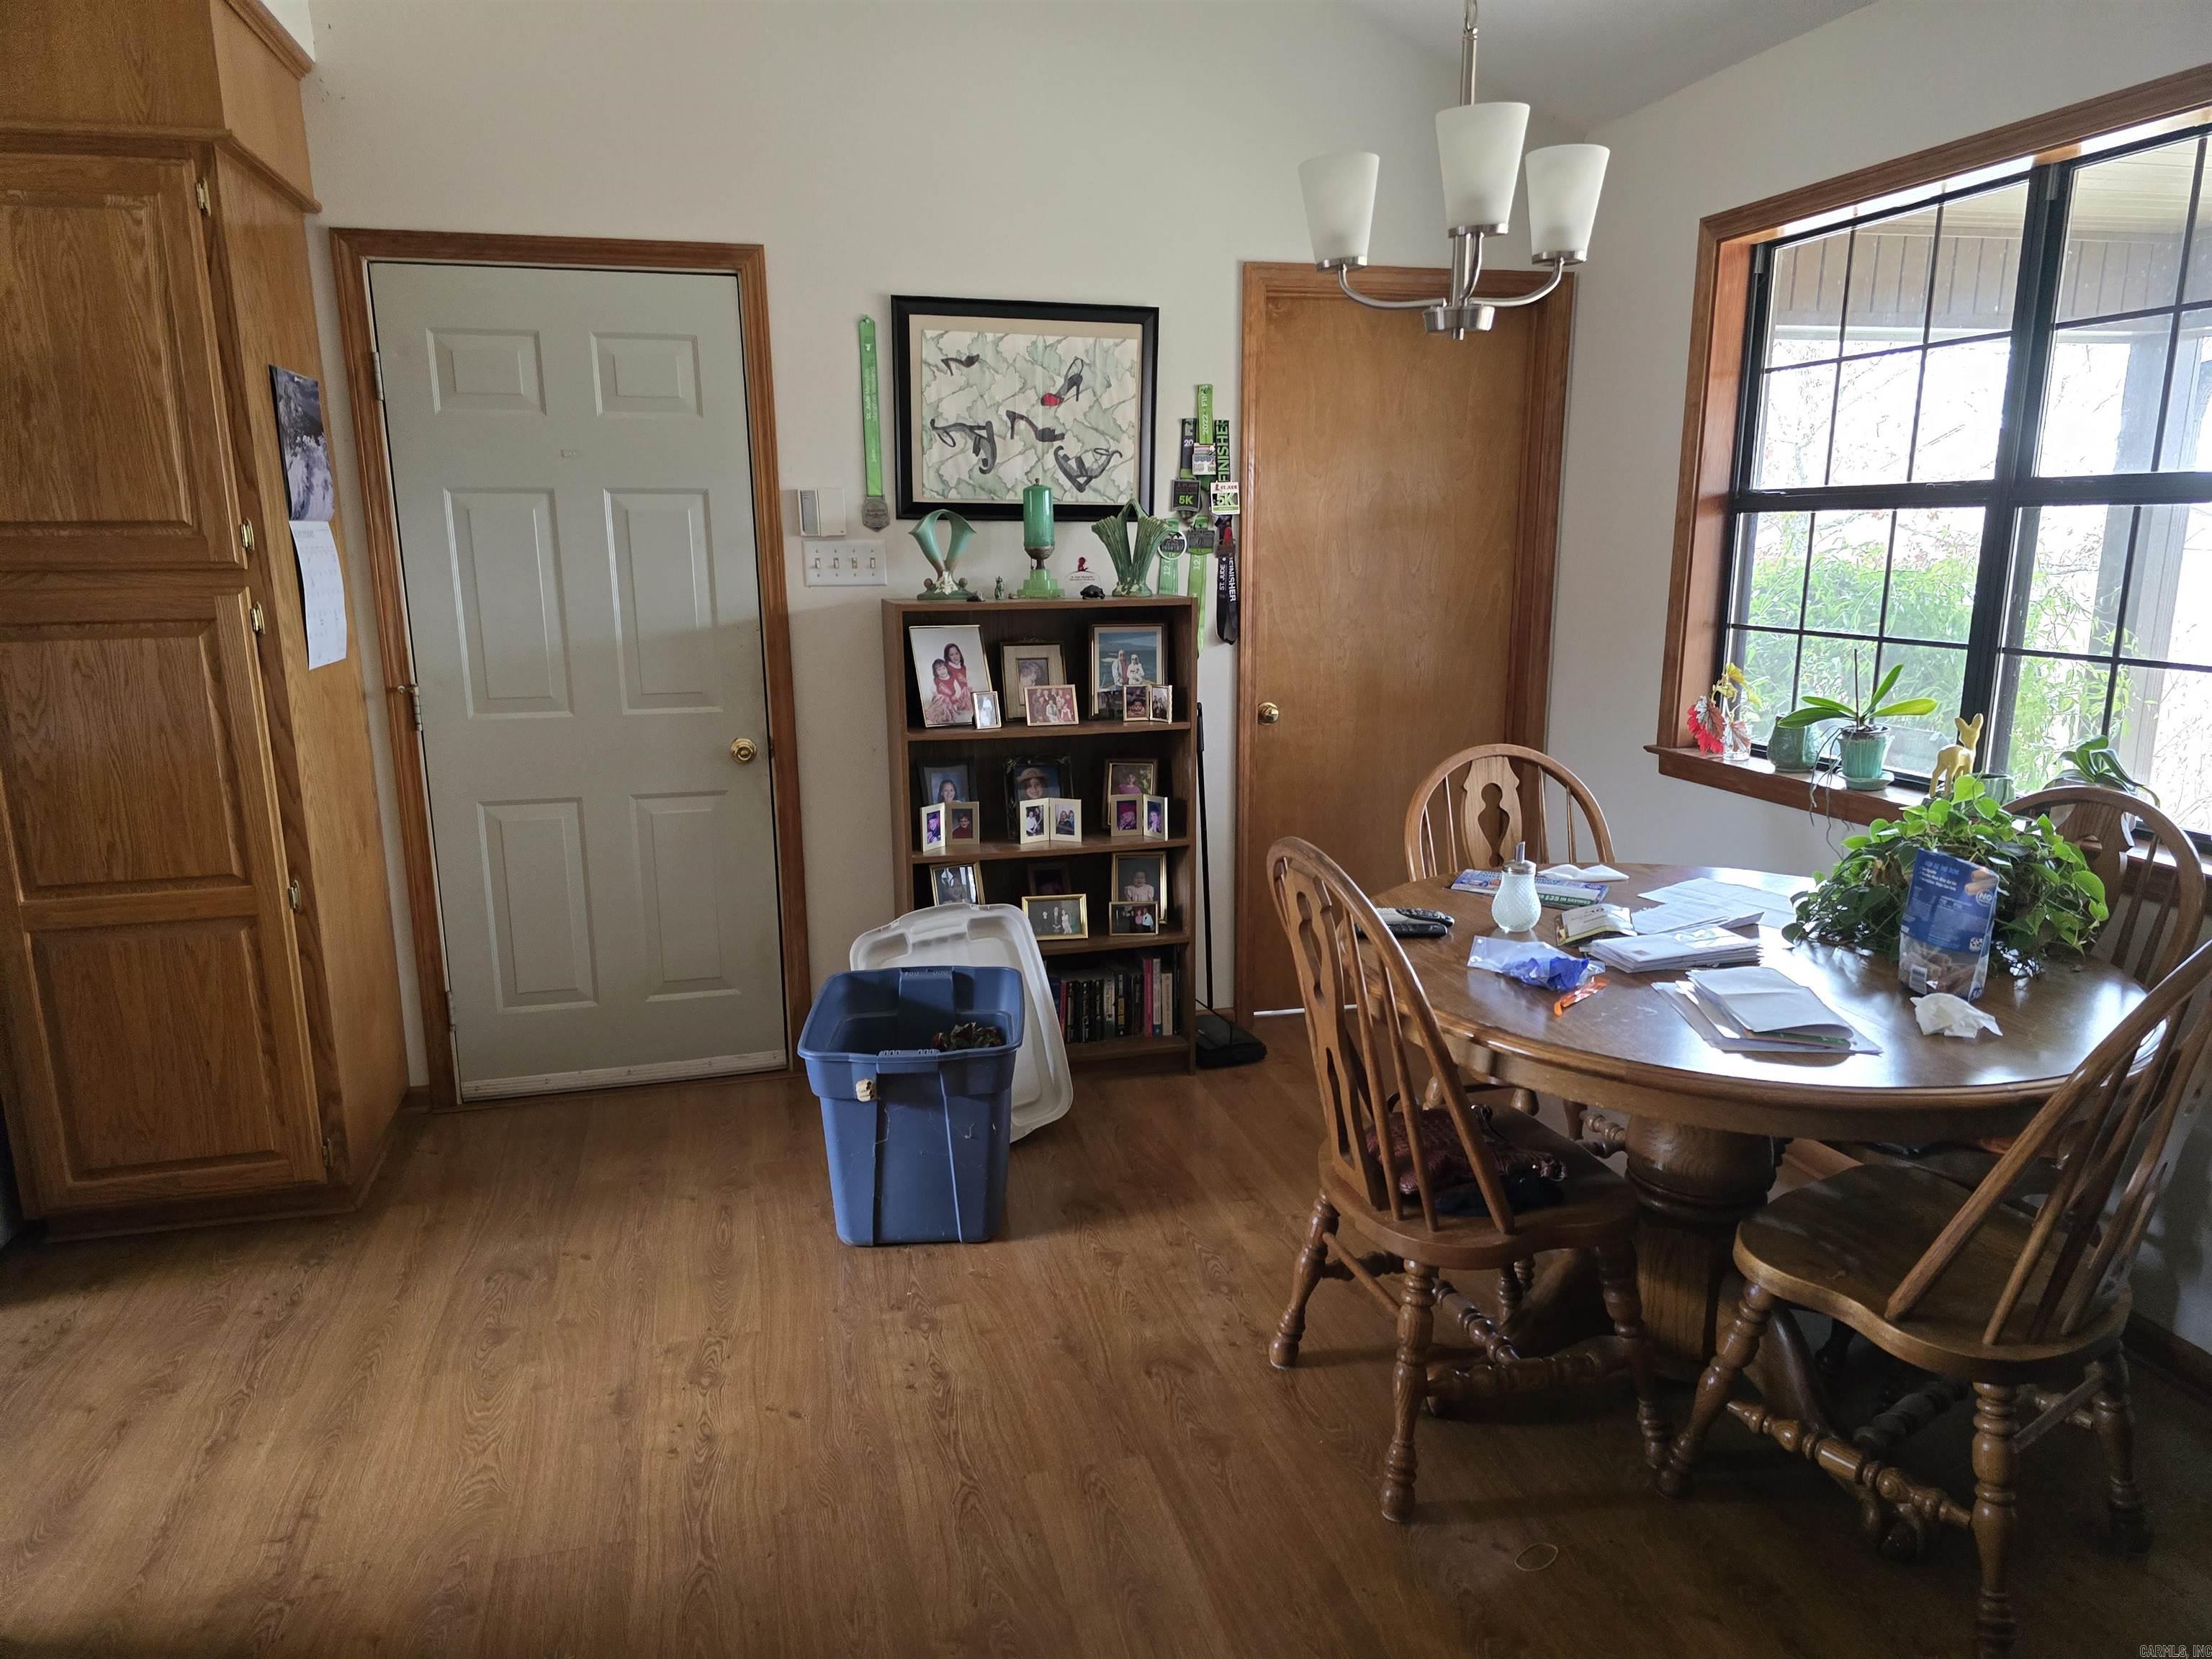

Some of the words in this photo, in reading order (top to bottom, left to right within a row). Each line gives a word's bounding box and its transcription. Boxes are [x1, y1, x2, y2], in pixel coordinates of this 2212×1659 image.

[1179, 495, 1194, 505] 5K
[1216, 492, 1233, 505] 5K
[1567, 896, 1591, 905] SAVINGS
